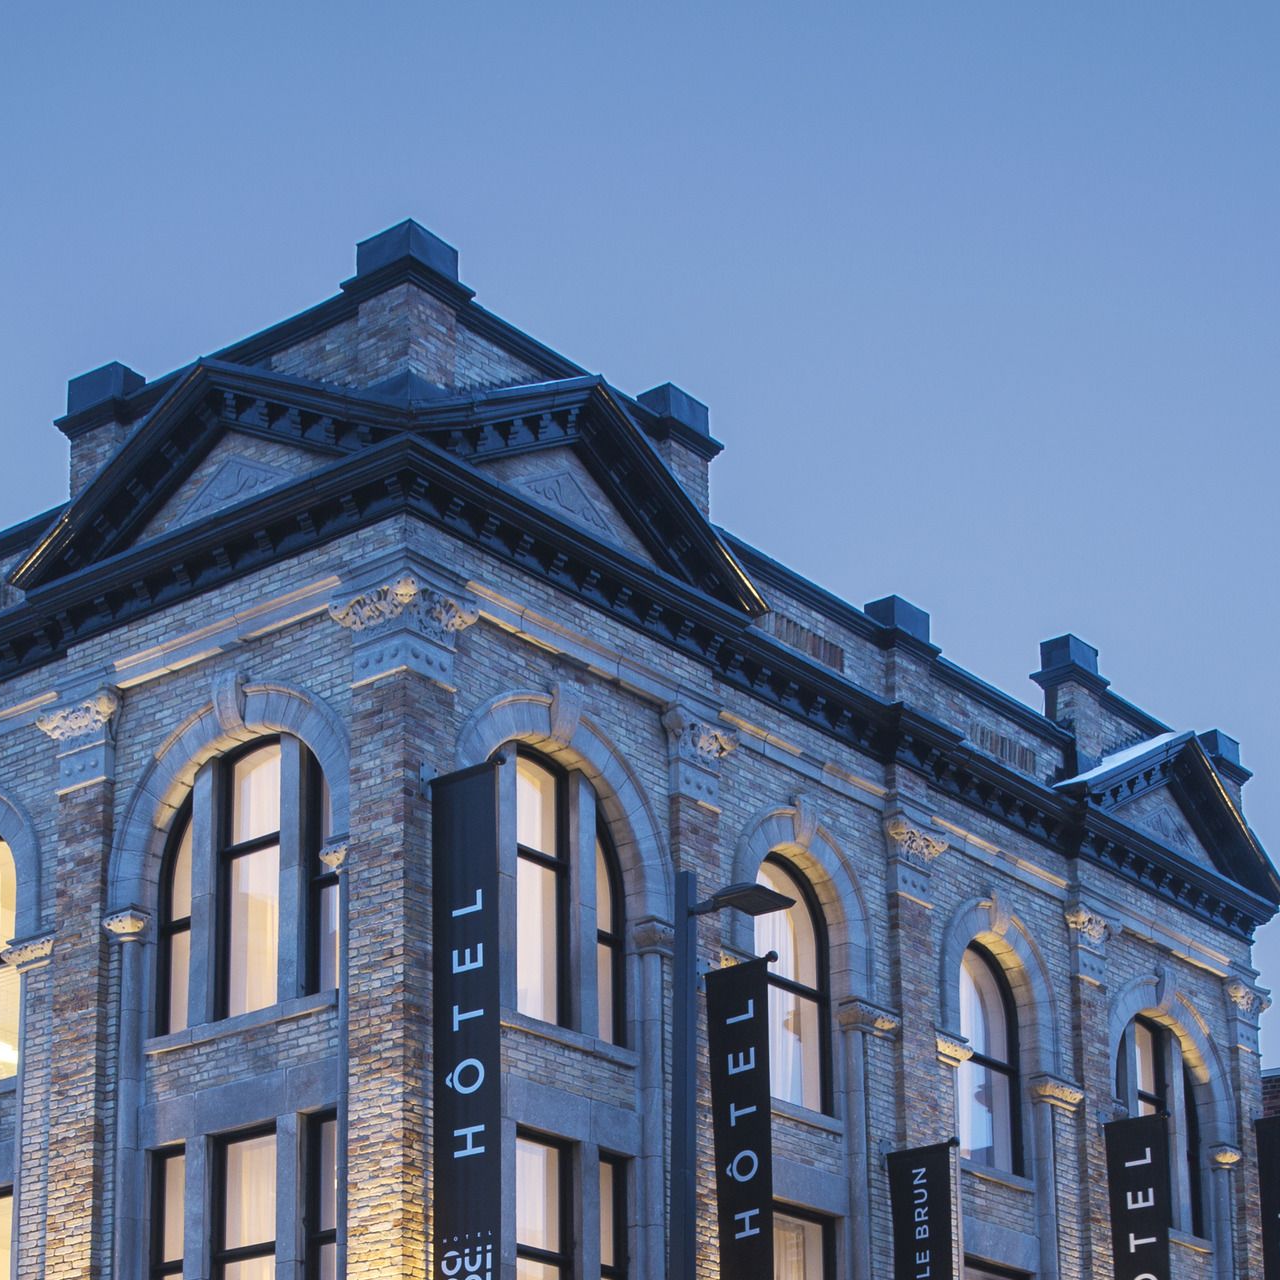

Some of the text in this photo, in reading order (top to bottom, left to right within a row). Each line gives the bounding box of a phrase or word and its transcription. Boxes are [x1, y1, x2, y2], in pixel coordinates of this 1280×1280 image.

[445, 888, 486, 1159] HÔTEL
[725, 998, 760, 1240] HÔTEL
[911, 1167, 931, 1279] LE BRUN
